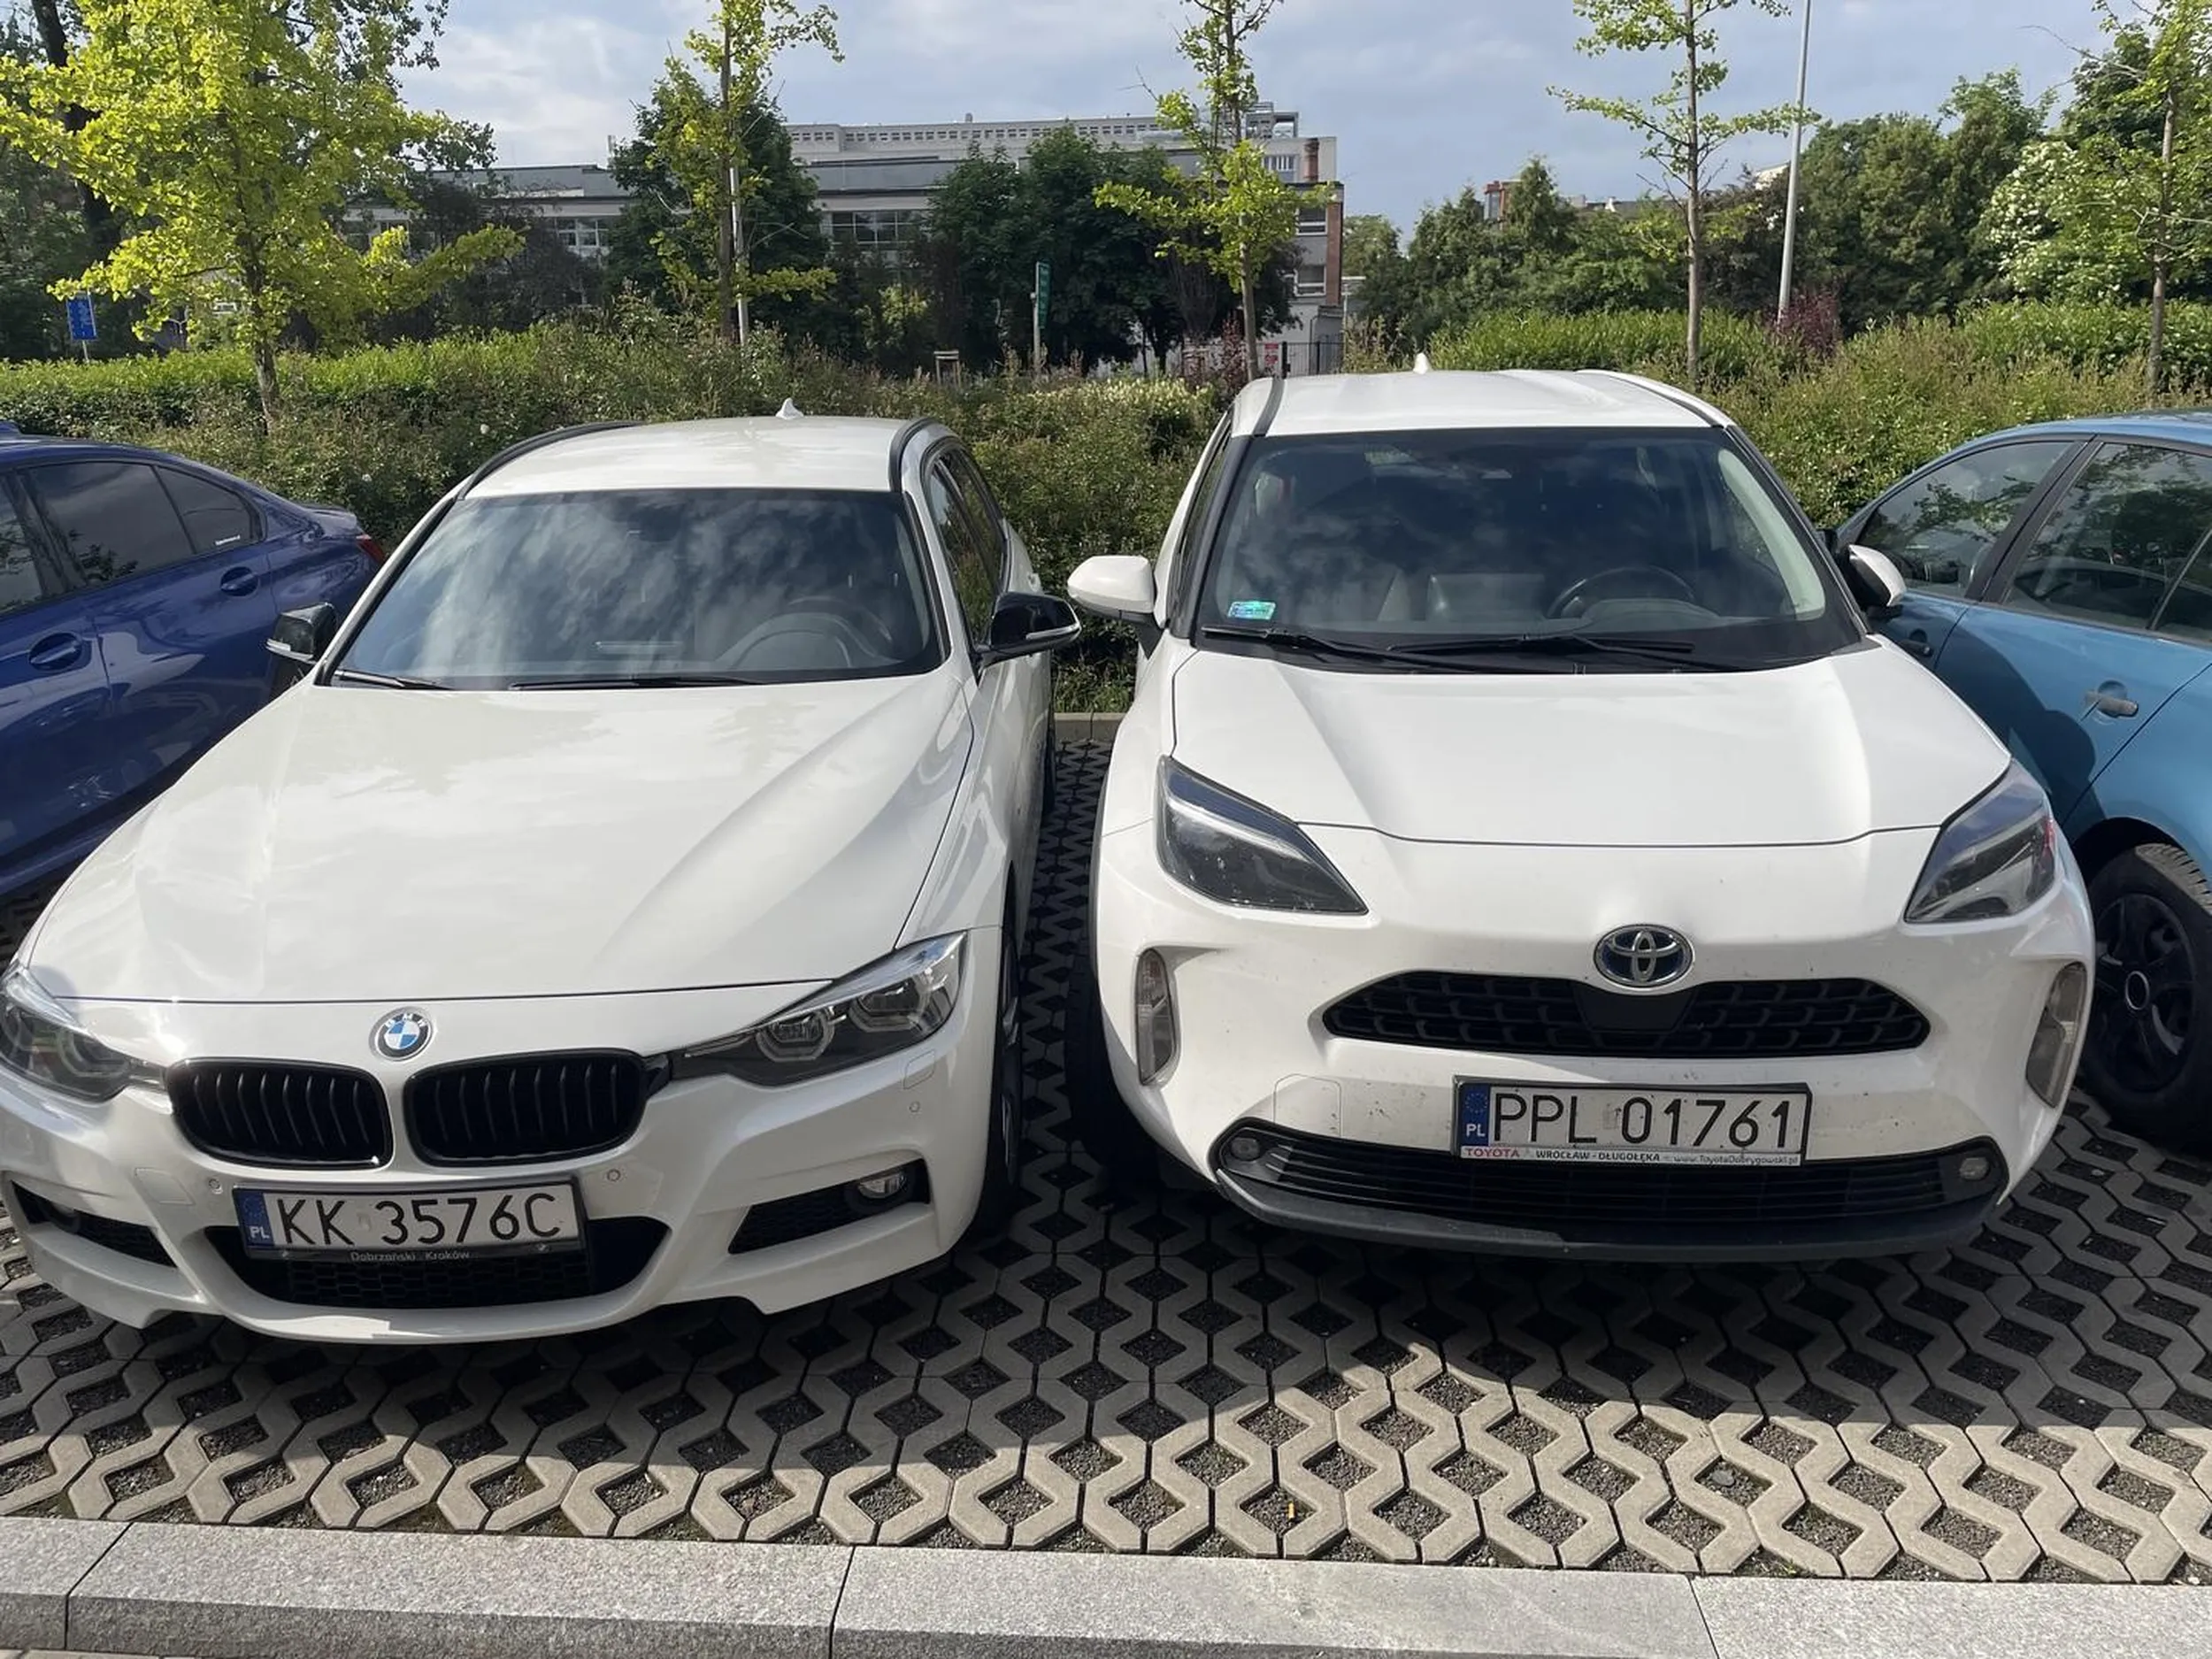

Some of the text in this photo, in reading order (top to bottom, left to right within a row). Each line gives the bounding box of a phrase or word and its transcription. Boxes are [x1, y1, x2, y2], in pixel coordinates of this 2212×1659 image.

[384, 1011, 428, 1028] BMW
[1494, 1093, 1790, 1148] PPL 01761
[1465, 1124, 1486, 1137] PL
[1465, 1148, 1521, 1158] TOYOTA
[1535, 1150, 1590, 1160] WROCŁAW
[276, 1192, 561, 1246] KK 3576C
[249, 1225, 271, 1240] PL
[425, 1249, 471, 1260] Kraków
